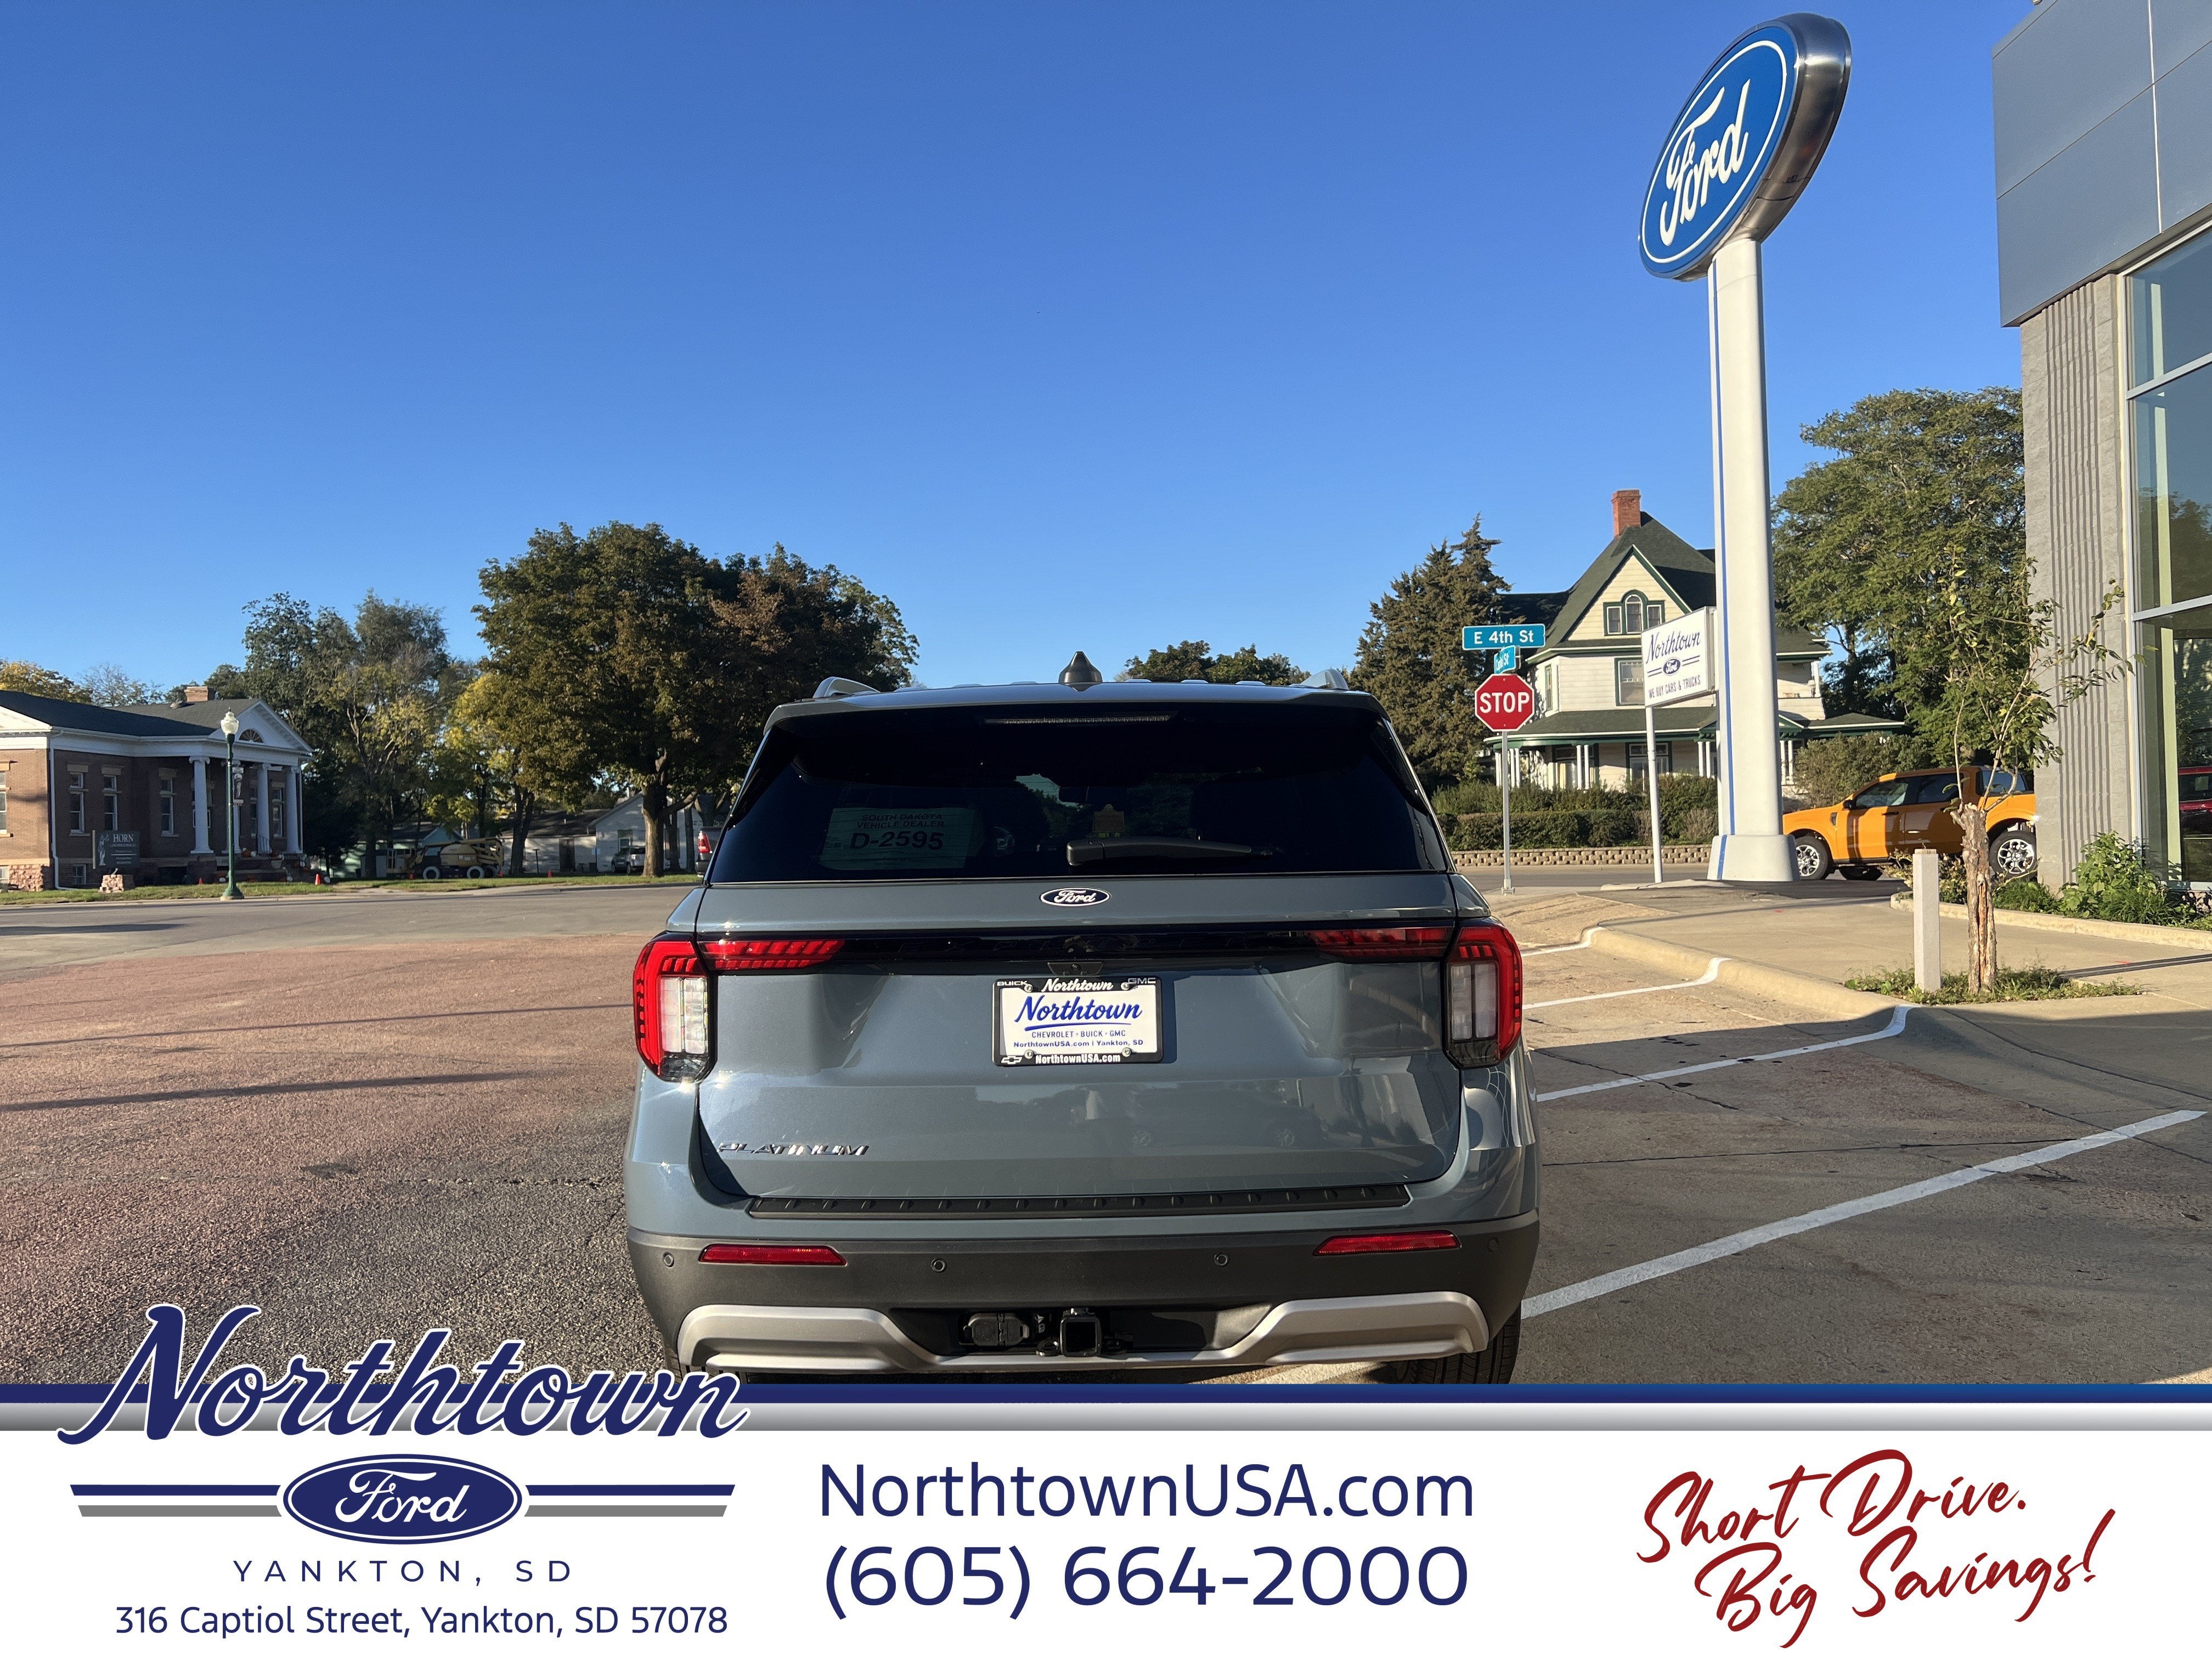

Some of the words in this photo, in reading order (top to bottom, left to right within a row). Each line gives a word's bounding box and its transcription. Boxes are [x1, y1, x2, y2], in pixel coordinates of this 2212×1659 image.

[1660, 78, 1751, 246] Ford
[1474, 631, 1483, 645] E
[1488, 630, 1513, 644] 4th
[1519, 630, 1534, 643] St
[1646, 630, 1701, 664] Northtown
[1649, 689, 1655, 699] WE
[1656, 686, 1664, 697] BUY
[1665, 681, 1677, 694] CARS
[1678, 680, 1681, 691] &
[1683, 674, 1701, 688] TRUCKS
[1479, 691, 1530, 714] STOP
[857, 821, 900, 830] VEHICLE
[113, 833, 134, 843] HORN
[850, 830, 945, 850] D-2595
[1053, 890, 1097, 903] Ford
[1041, 978, 1114, 992] Northtown
[1014, 995, 1143, 1023] Northtown
[1035, 1054, 1121, 1064] NorthtownUSA.com
